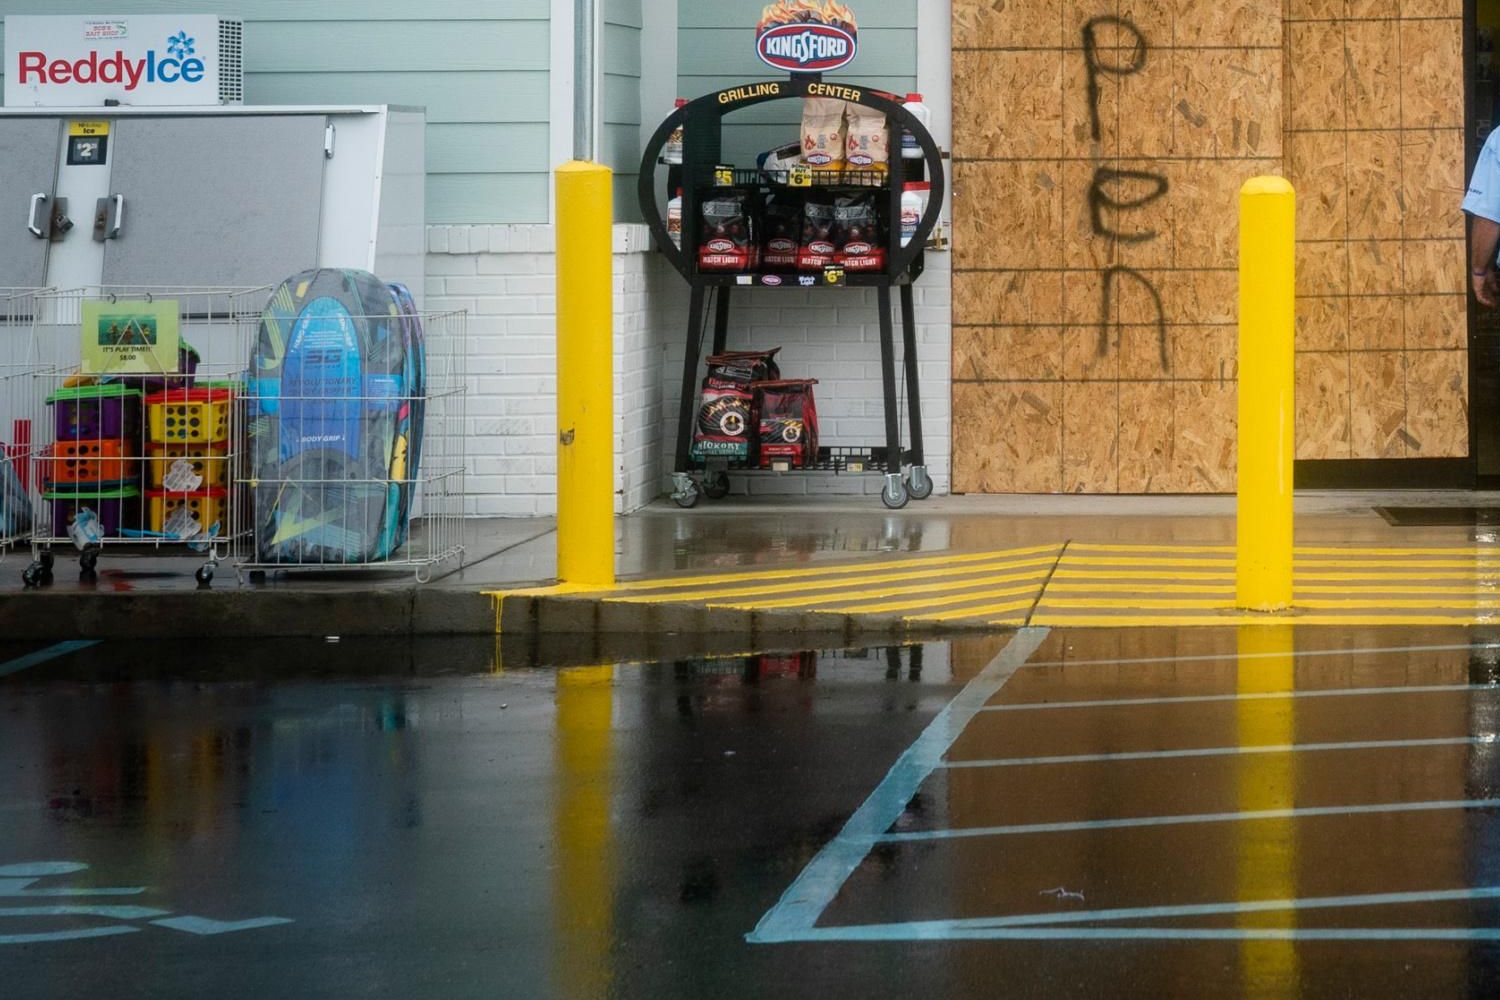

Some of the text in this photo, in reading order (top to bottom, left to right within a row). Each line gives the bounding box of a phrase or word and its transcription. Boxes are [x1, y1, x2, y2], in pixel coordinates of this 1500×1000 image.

[766, 30, 847, 63] KINGSFORD
[718, 83, 861, 104] GRILLING CENTER
[703, 256, 738, 264] MATCH LIGHT
[860, 257, 876, 266] LIGHT
[300, 434, 341, 443] BODY GRIP
